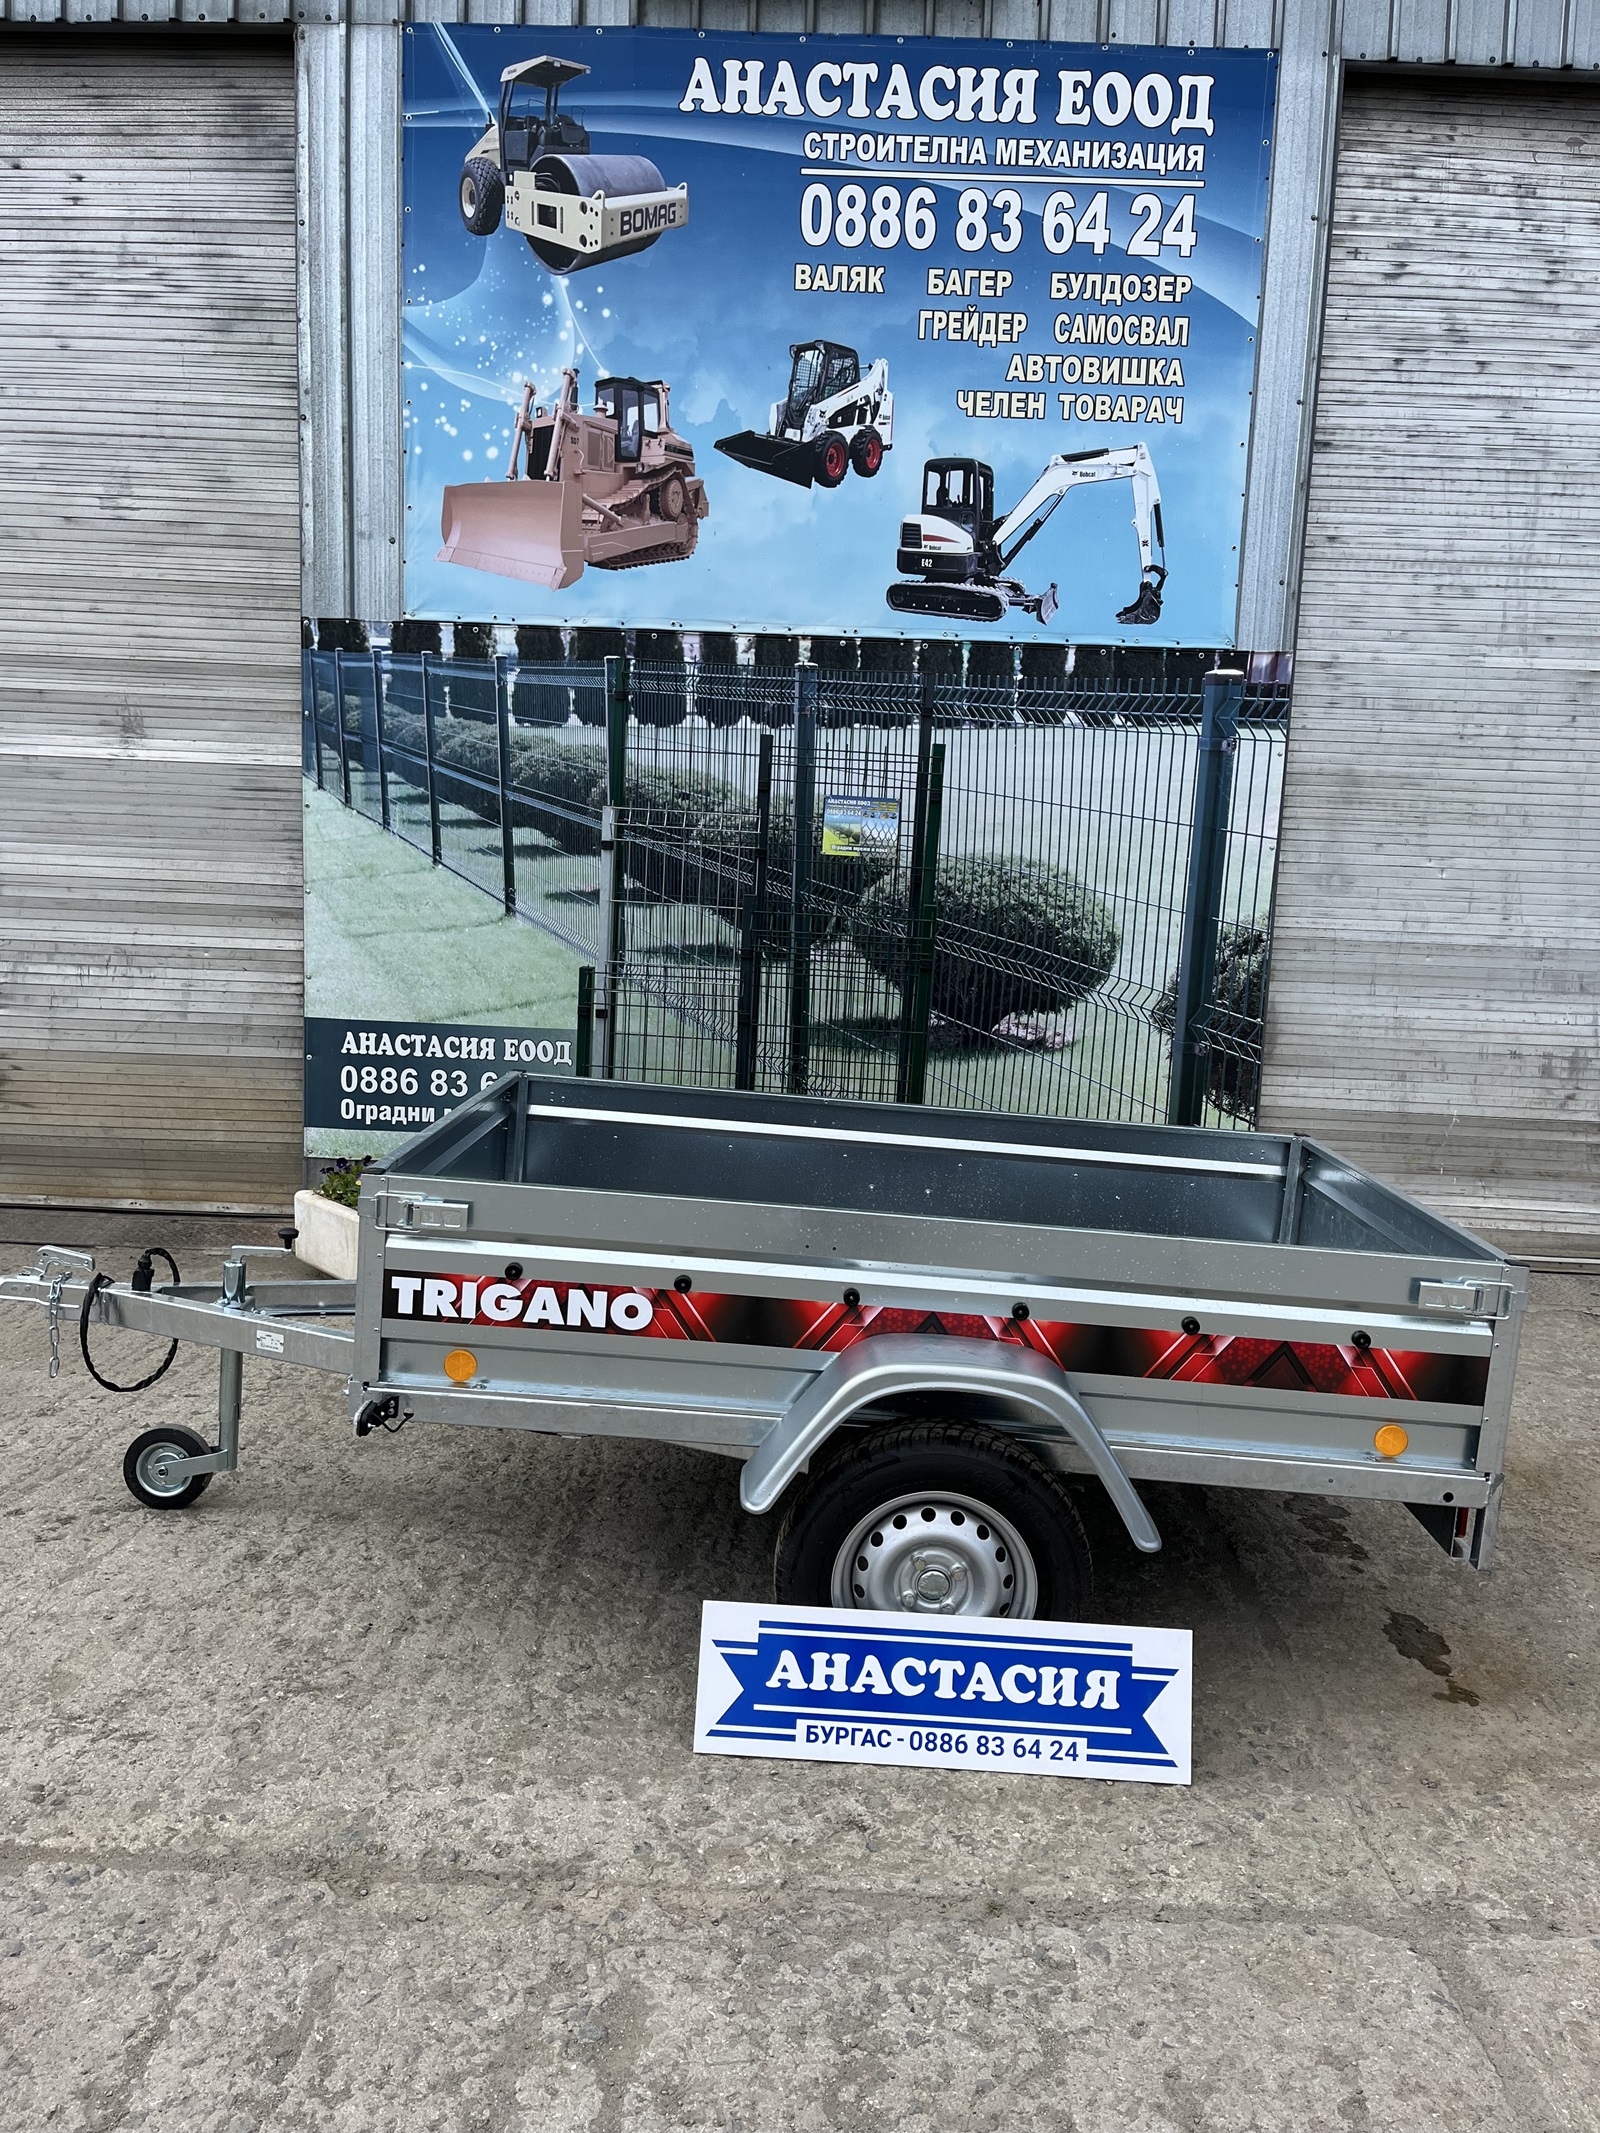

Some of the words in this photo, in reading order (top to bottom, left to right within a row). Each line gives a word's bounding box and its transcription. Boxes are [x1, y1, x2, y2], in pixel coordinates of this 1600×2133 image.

[679, 57, 1039, 124] АНАСТАСИЯ
[1055, 69, 1215, 137] ЕООД
[802, 131, 987, 166] СТРОИТЕЛНА
[994, 138, 1205, 176] МЕХАНИЗАЦИЯ
[619, 202, 677, 237] BOMAG
[801, 182, 937, 250] 0886
[956, 188, 1022, 253] 83
[1042, 191, 1111, 255] 64
[1127, 193, 1197, 257] 24
[795, 263, 885, 293] ВАЛЯК
[927, 268, 1012, 298] БАГЕР
[1050, 272, 1193, 304] БУЛДОЗЕР
[918, 305, 1027, 347] ГРЕЙДЕР
[1054, 313, 1189, 346] САМОСВАЛ
[1006, 354, 1184, 387] АВТОВИШКА
[957, 390, 1045, 420] ЧЕЛЕН
[1059, 393, 1184, 424] ТОВАРАЧ
[1079, 470, 1096, 478] Bobcat
[921, 558, 933, 568] E42
[340, 1031, 496, 1060] АНАСТАСИЯ
[503, 1038, 573, 1066] ЕООД
[340, 1065, 419, 1095] 0886
[430, 1069, 468, 1097] 83
[340, 1098, 435, 1125] Оградни
[391, 1275, 653, 1331] TRIGANO
[765, 1649, 1121, 1710] АНАСТАСИЯ
[805, 1725, 892, 1749] БУРГАС
[908, 1730, 968, 1755] 0886
[975, 1734, 1005, 1757] 83
[1013, 1738, 1043, 1760] 64
[1049, 1740, 1080, 1762] 24
